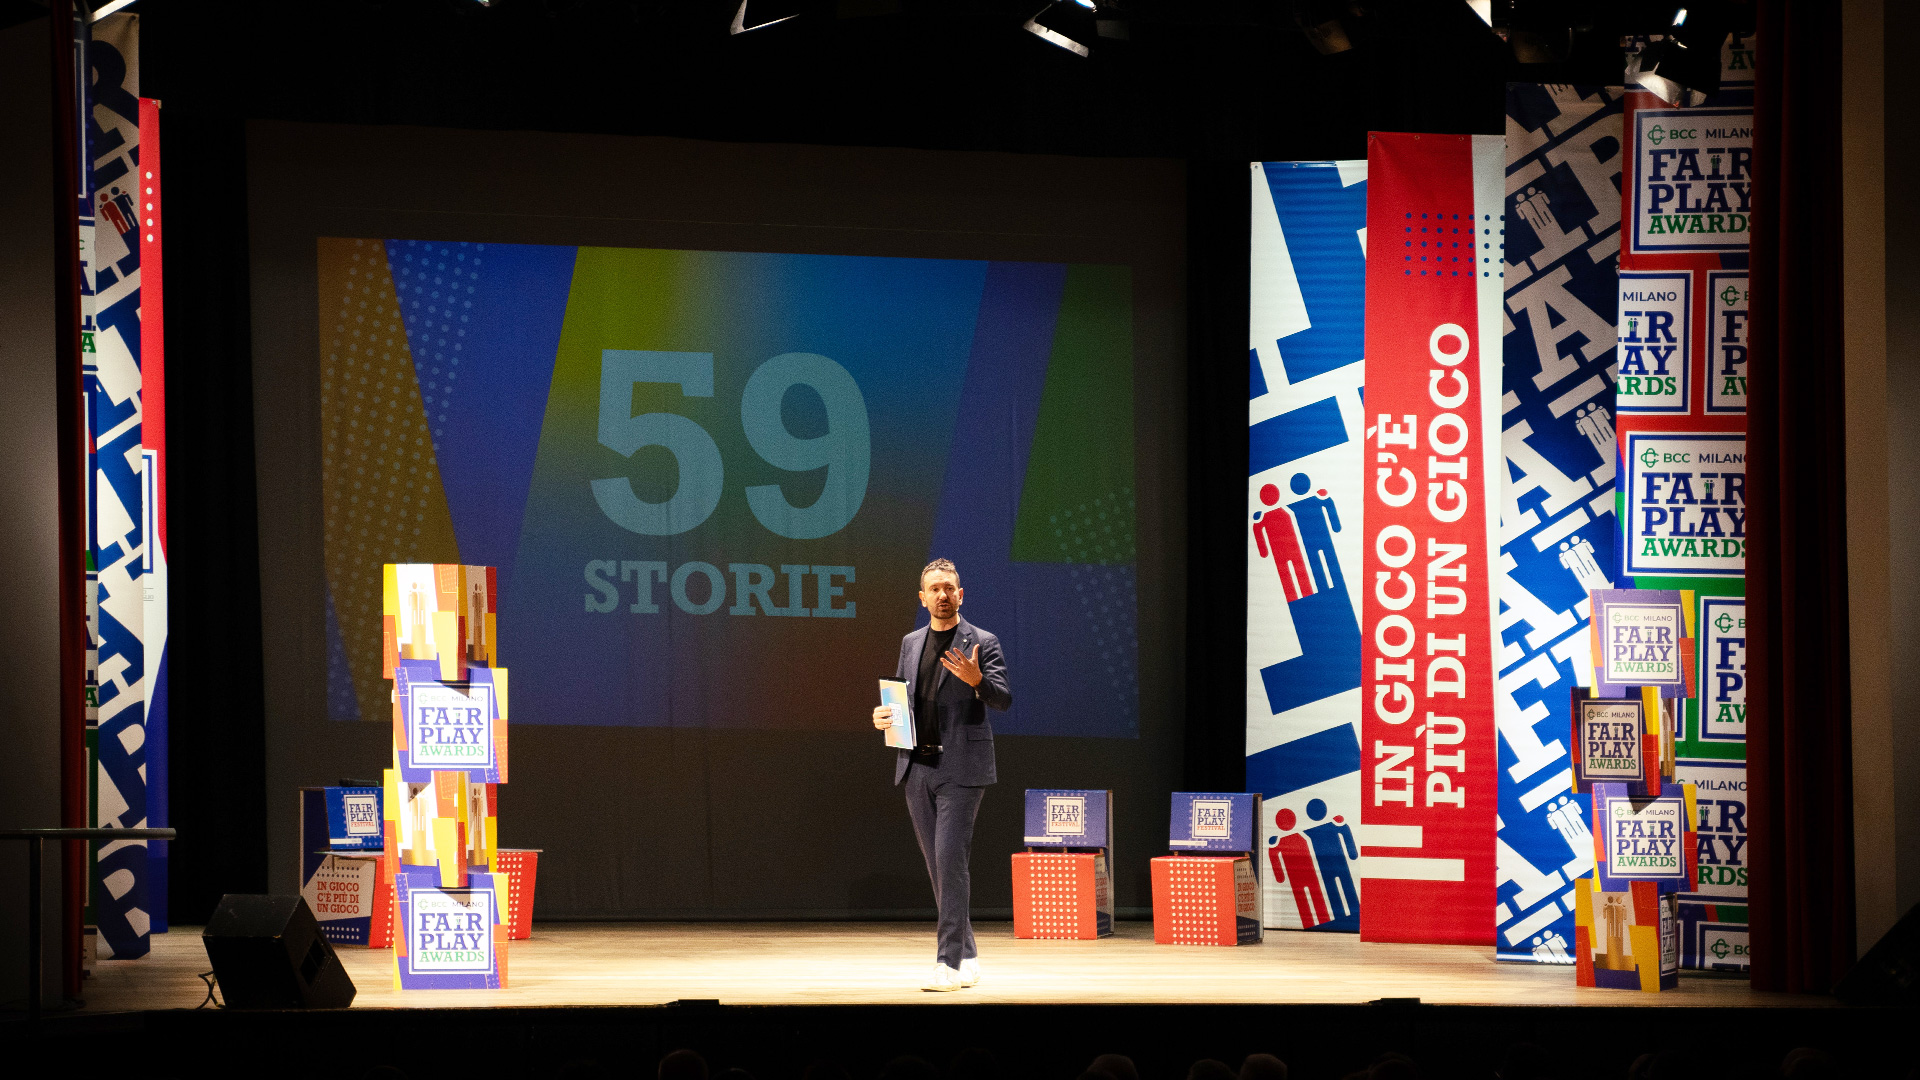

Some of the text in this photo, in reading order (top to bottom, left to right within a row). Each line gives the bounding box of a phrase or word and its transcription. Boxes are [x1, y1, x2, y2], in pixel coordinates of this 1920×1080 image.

[1669, 128, 1753, 139] BCC MILAN
[1647, 214, 1751, 234] AWARD
[1622, 291, 1677, 302] MILANO
[590, 349, 872, 540] 59
[1663, 453, 1746, 464] BCC MILAN
[1415, 323, 1470, 809] PIÙ DI UN GIOCO
[583, 559, 857, 619] STORIE
[1374, 525, 1417, 725] GIOCO
[1613, 626, 1674, 644] FAIR
[1613, 645, 1674, 662] PLAY
[1613, 662, 1674, 673] AWARDS
[418, 707, 484, 725] FAIR
[418, 727, 484, 745] PLAY
[1587, 722, 1636, 741] FAIR
[419, 745, 485, 756] AWARDS
[1588, 741, 1636, 758] PLAY
[1588, 759, 1637, 770] AWARDS
[1374, 740, 1414, 808] IN
[349, 803, 374, 813] FAIR
[1051, 804, 1080, 814] FAIR
[1197, 808, 1226, 817] FAIR
[349, 813, 374, 822] PLAY
[1051, 813, 1080, 822] PLAY
[1197, 817, 1226, 826] PLAY
[1615, 820, 1676, 839] FAIR
[1616, 839, 1676, 856] PLAY
[1616, 856, 1677, 868] AWARDS
[316, 881, 360, 892] IN GIOCO
[333, 892, 348, 903] PIÙ
[350, 893, 360, 904] DI
[316, 903, 360, 914] UN GIOCO
[418, 913, 484, 932] FAIR
[419, 933, 484, 950] PLAY
[419, 951, 485, 962] AWARDS
